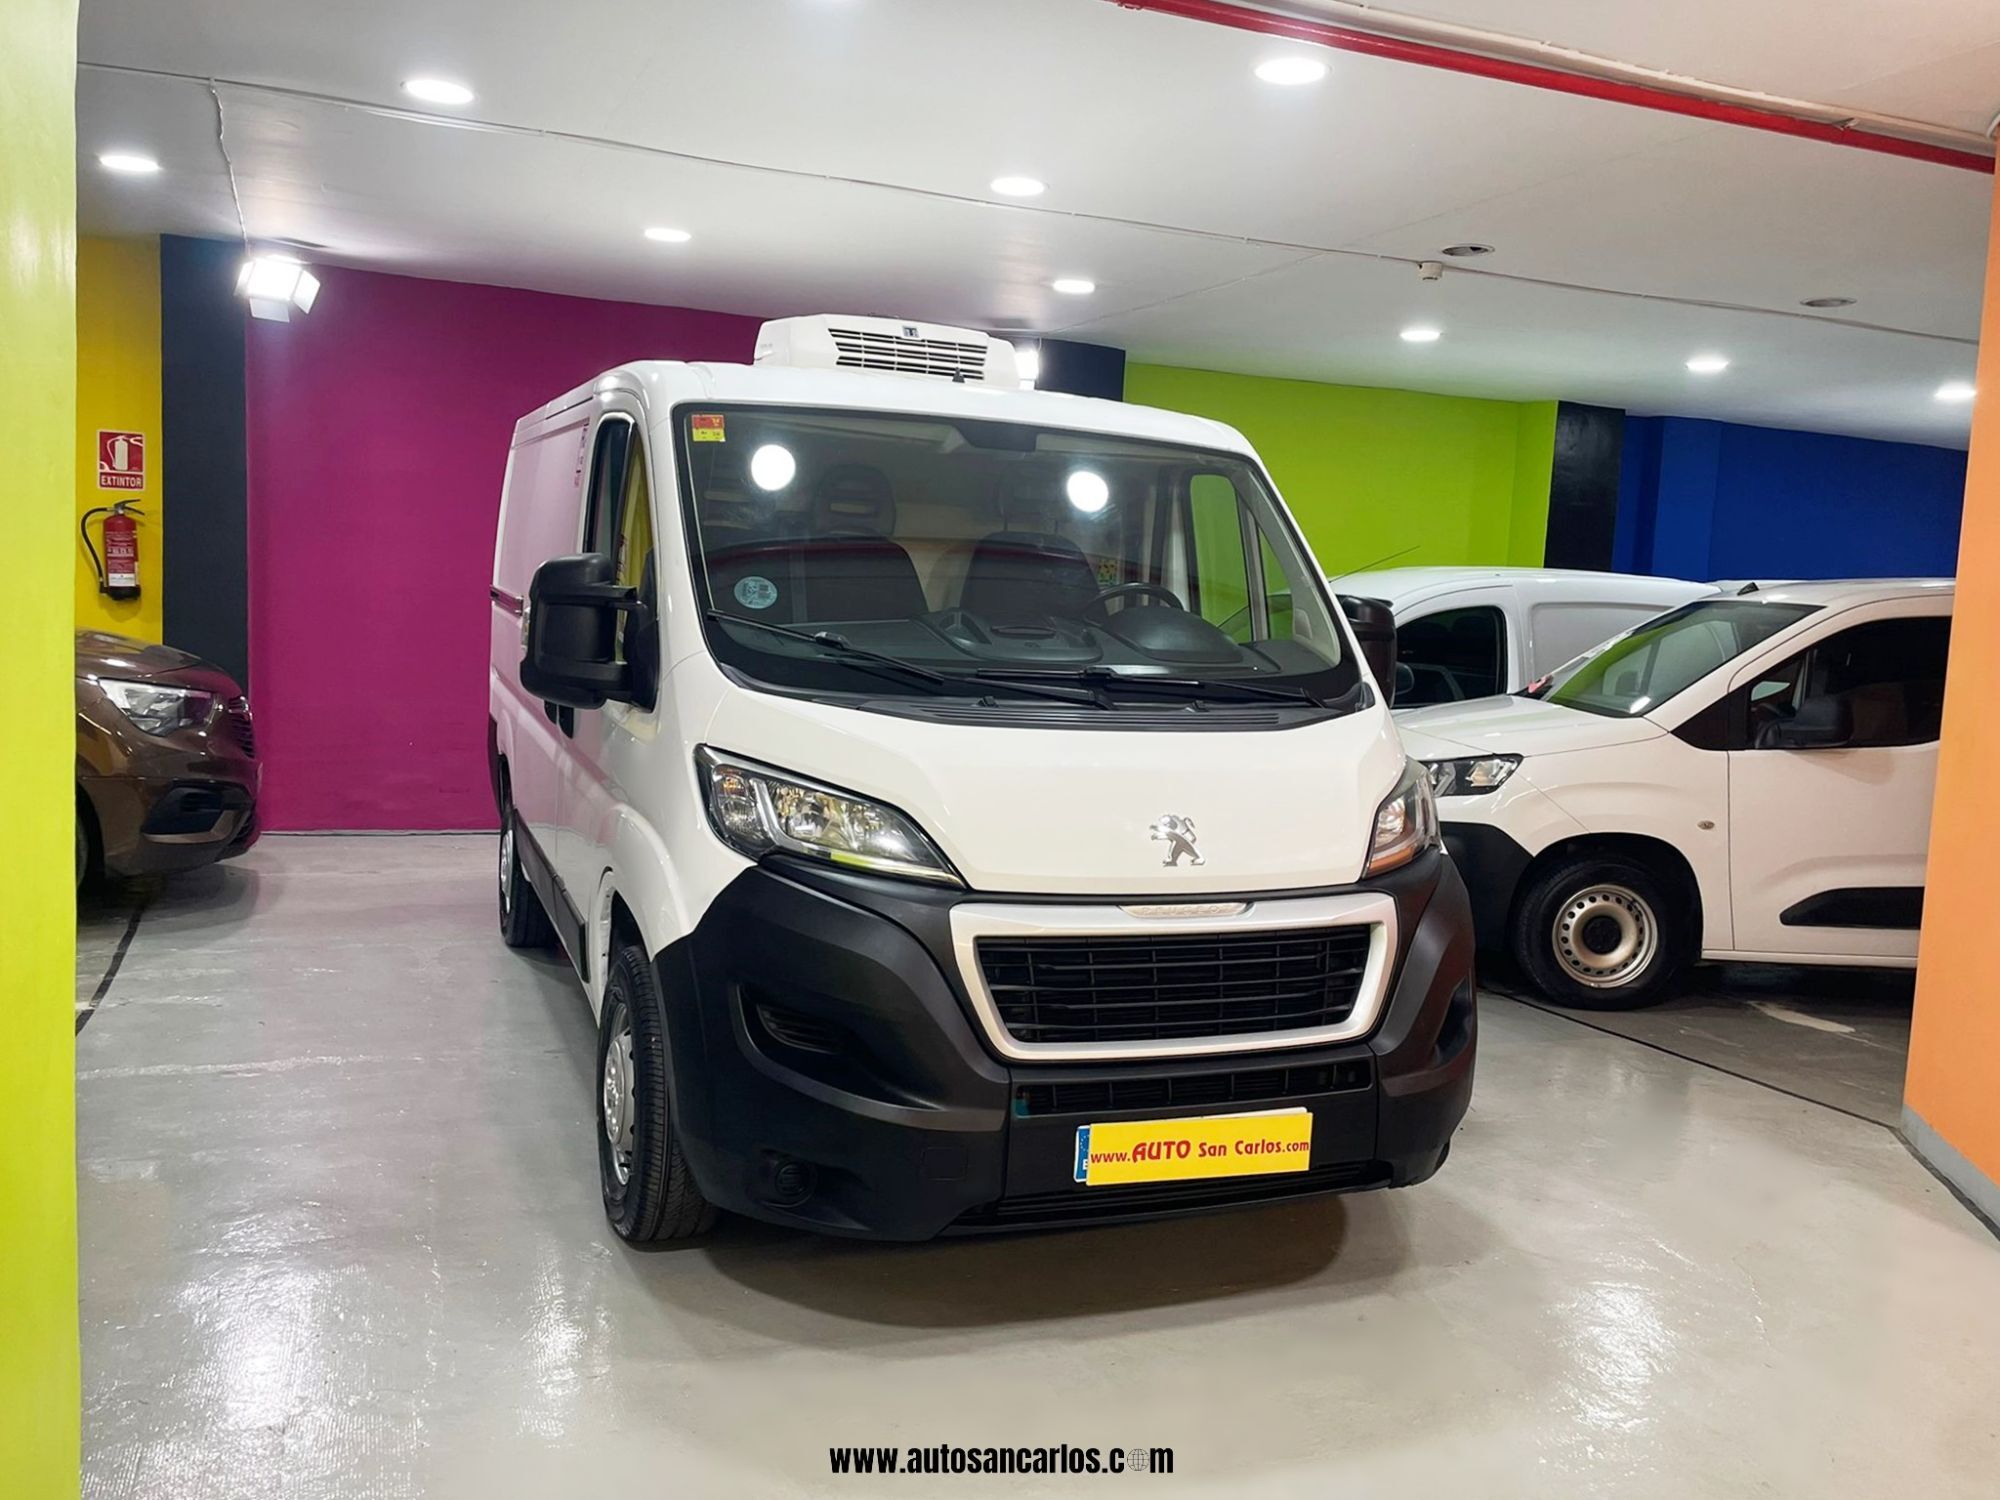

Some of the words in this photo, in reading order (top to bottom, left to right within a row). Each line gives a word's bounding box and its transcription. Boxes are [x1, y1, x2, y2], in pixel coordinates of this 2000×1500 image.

[101, 475, 142, 488] EXTINTOR
[1091, 1140, 1191, 1163] www.AUTO
[1198, 1142, 1227, 1158] San
[1234, 1138, 1310, 1156] Carlos.com
